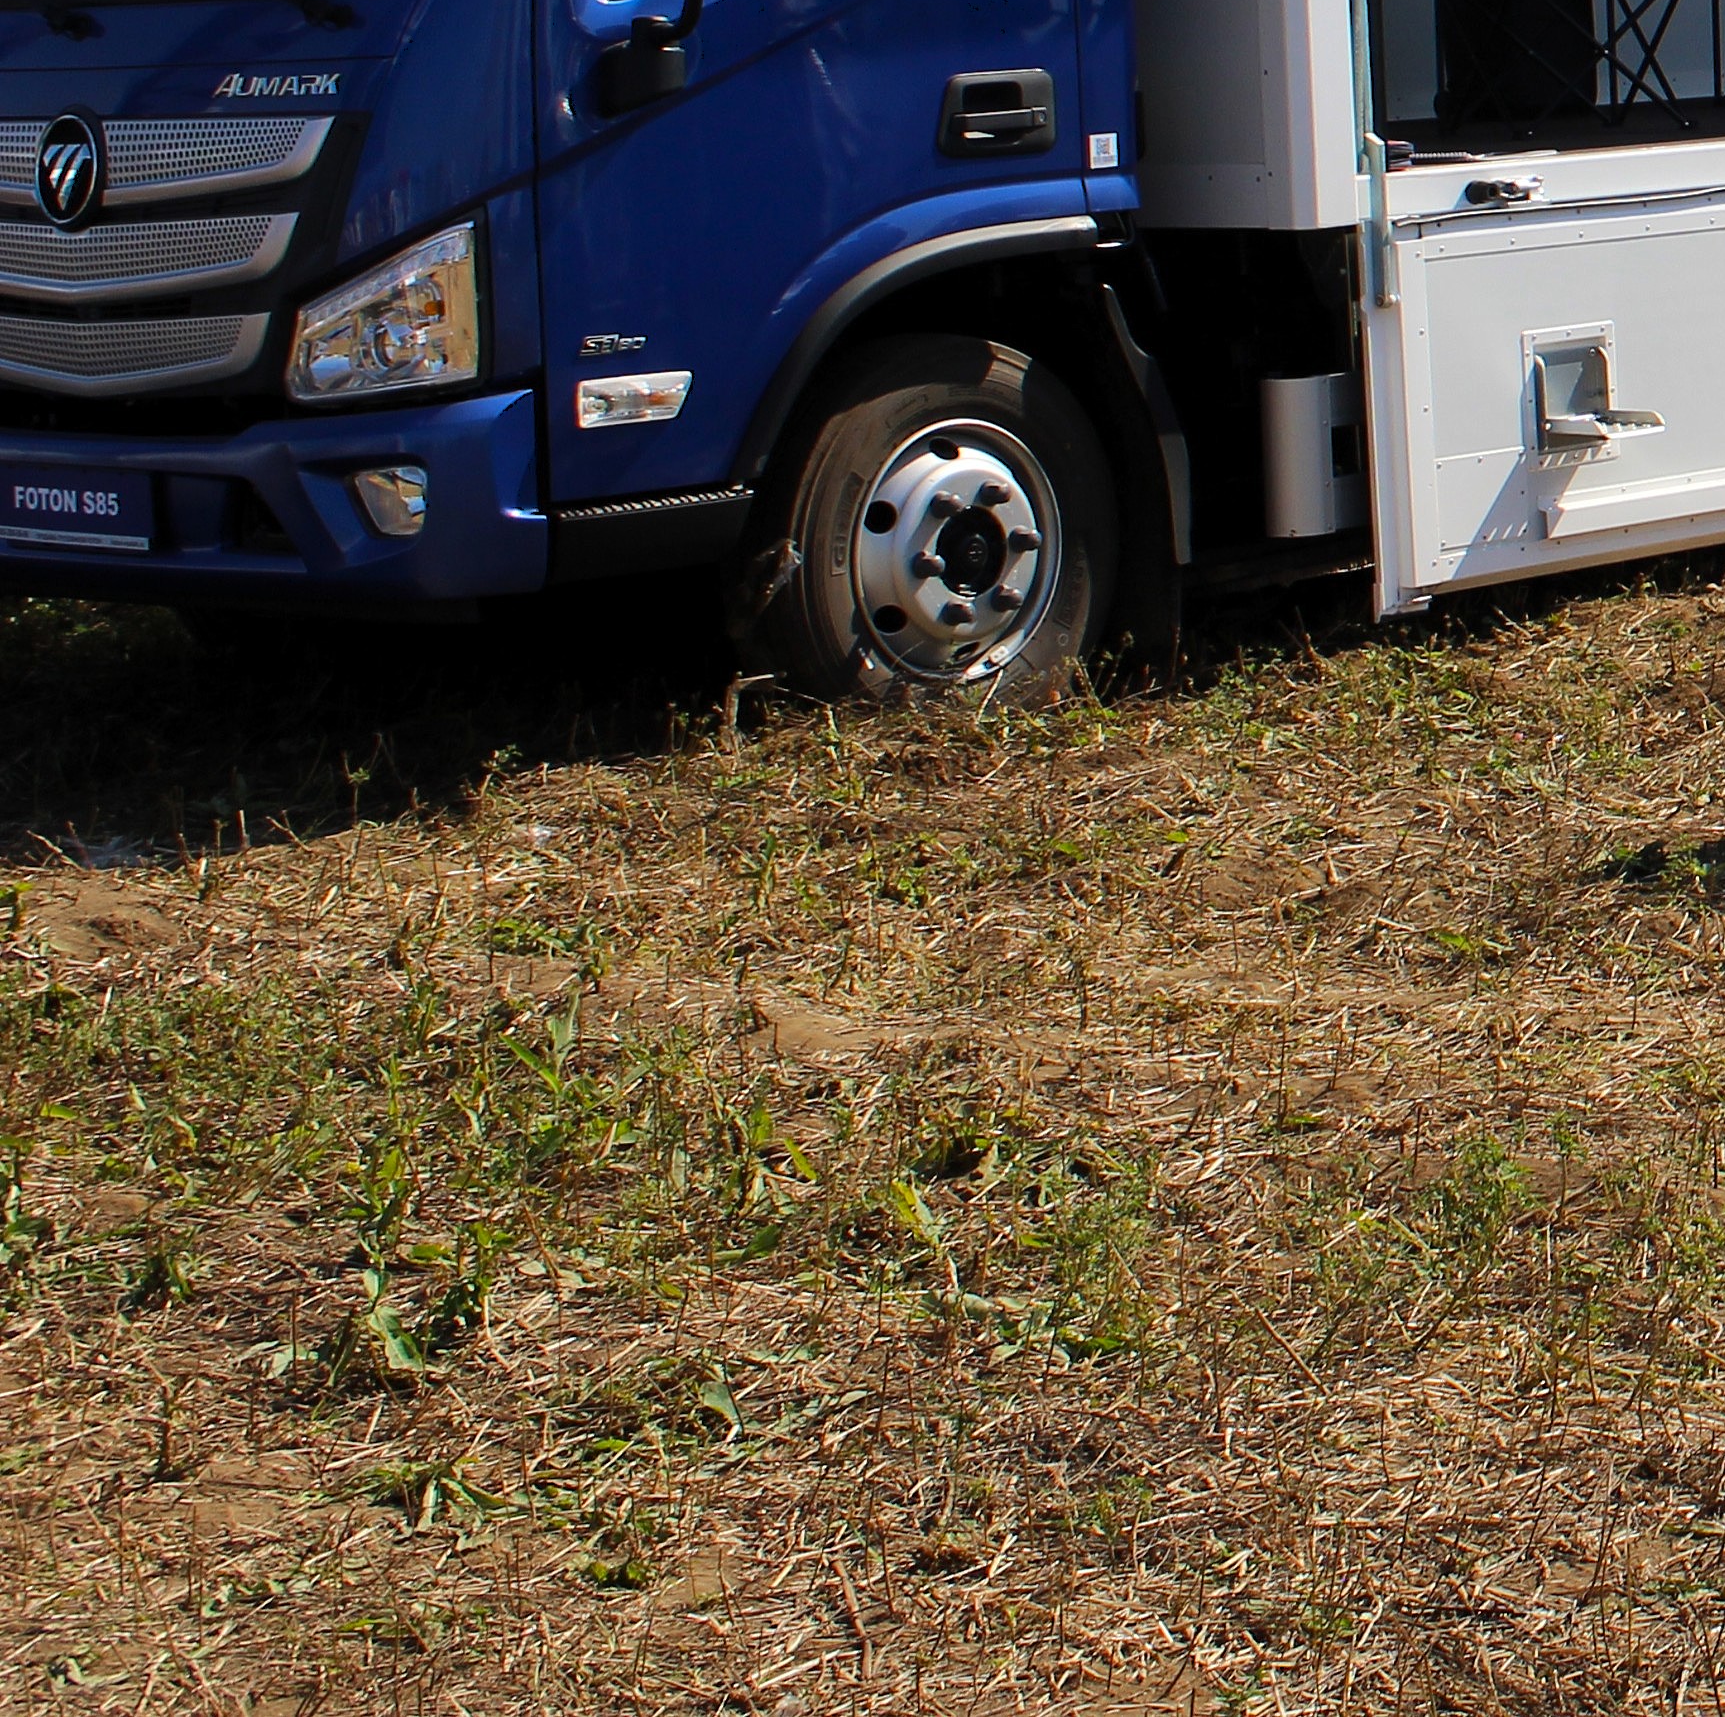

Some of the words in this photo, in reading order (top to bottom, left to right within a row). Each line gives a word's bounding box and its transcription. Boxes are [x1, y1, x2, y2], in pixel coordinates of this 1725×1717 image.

[212, 73, 340, 98] AUMARK
[13, 485, 78, 513] FOTON
[82, 490, 119, 516] S85
